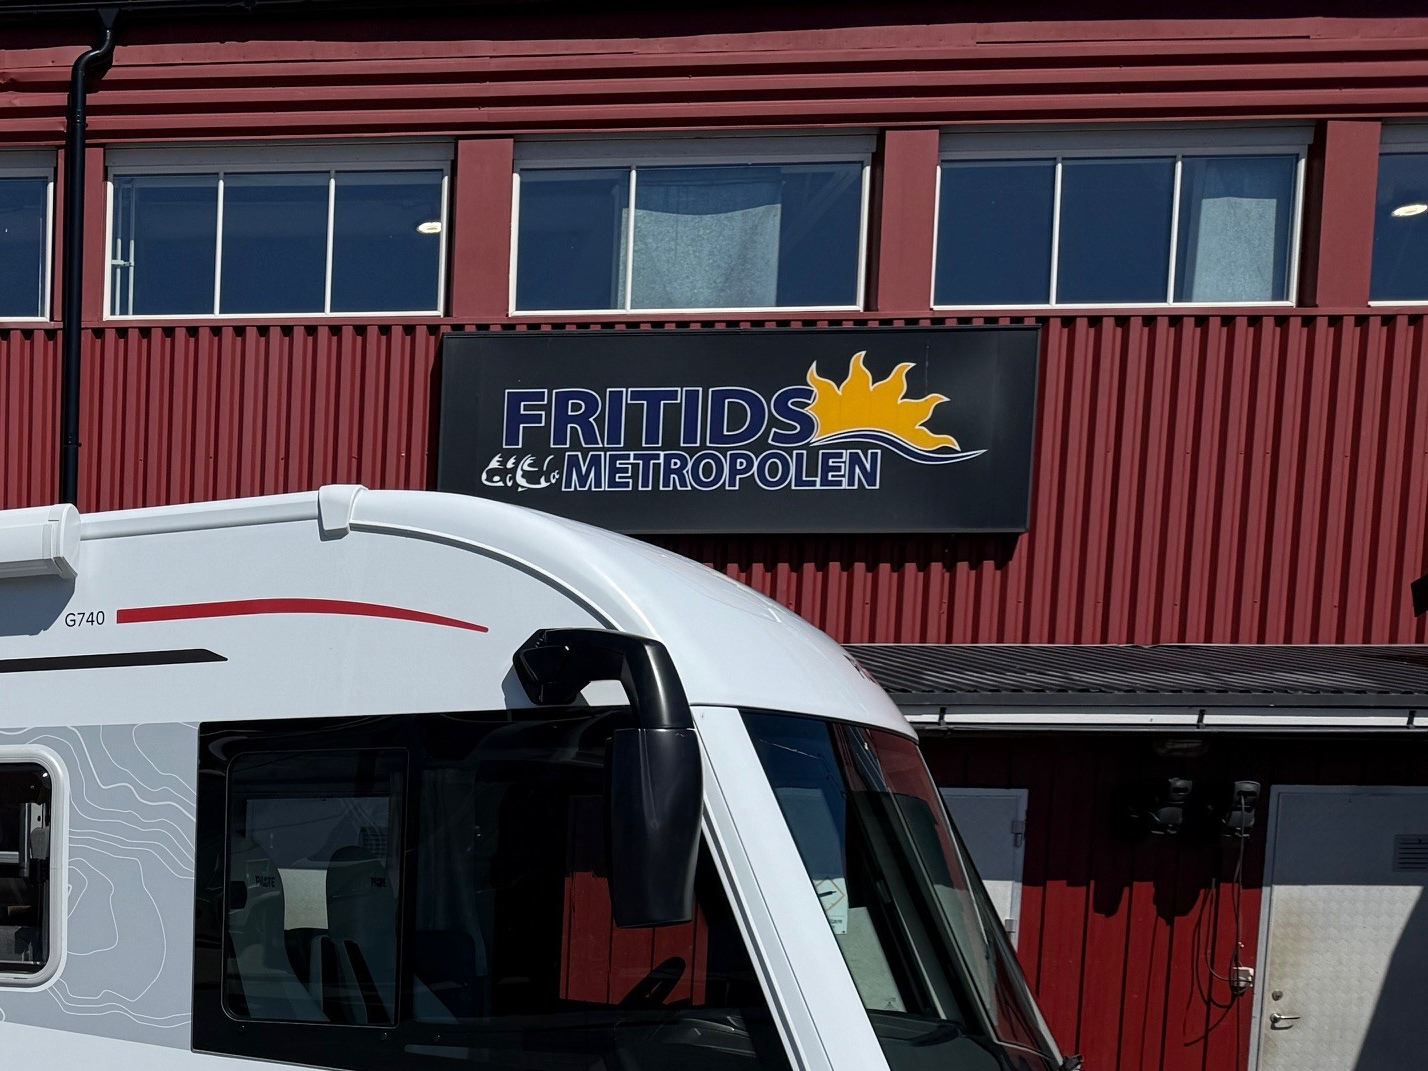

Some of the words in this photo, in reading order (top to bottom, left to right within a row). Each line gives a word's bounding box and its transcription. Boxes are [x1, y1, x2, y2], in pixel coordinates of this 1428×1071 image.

[502, 386, 817, 449] FRITIDS
[561, 449, 881, 491] METROPOLEN
[64, 610, 105, 628] G740
